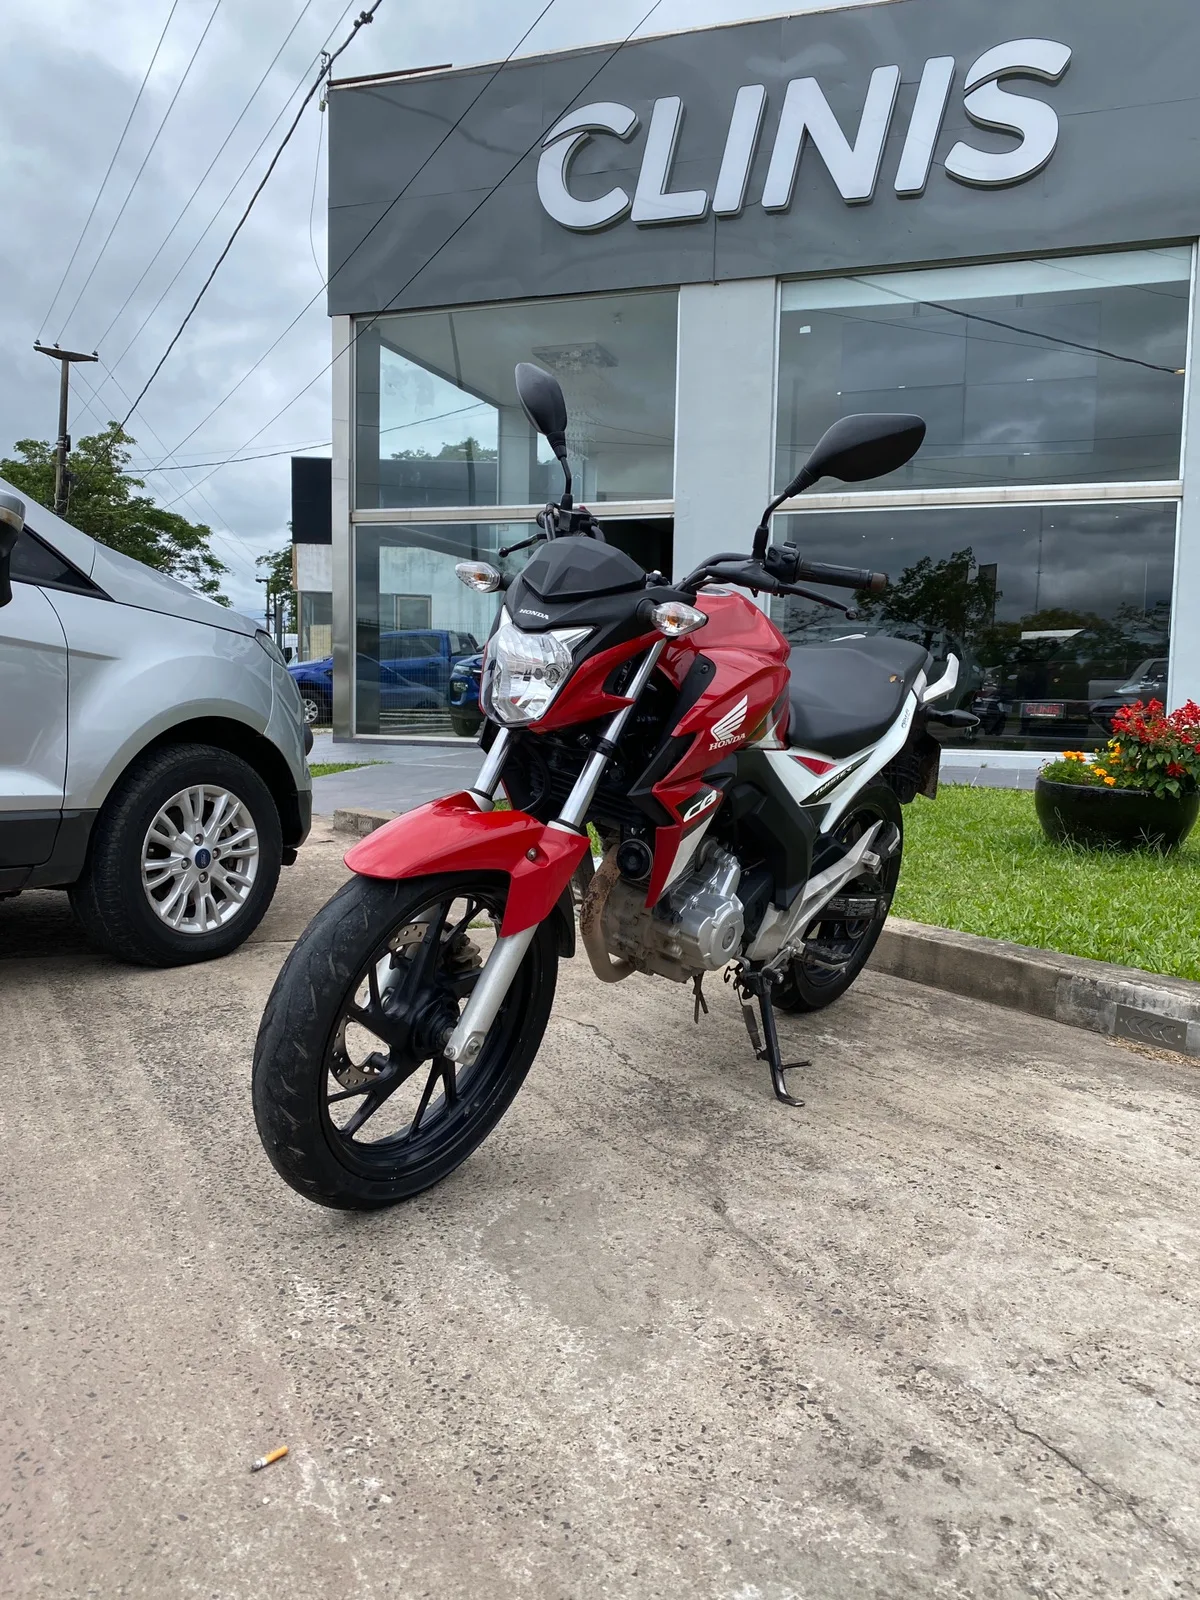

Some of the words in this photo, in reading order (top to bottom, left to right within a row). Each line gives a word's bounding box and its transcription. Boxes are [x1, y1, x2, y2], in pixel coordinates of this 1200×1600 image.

[536, 37, 1073, 231] CLINIS
[519, 608, 549, 620] HONDA
[1026, 705, 1060, 714] CLINIS
[708, 733, 746, 751] HONDA
[683, 789, 717, 823] CB
